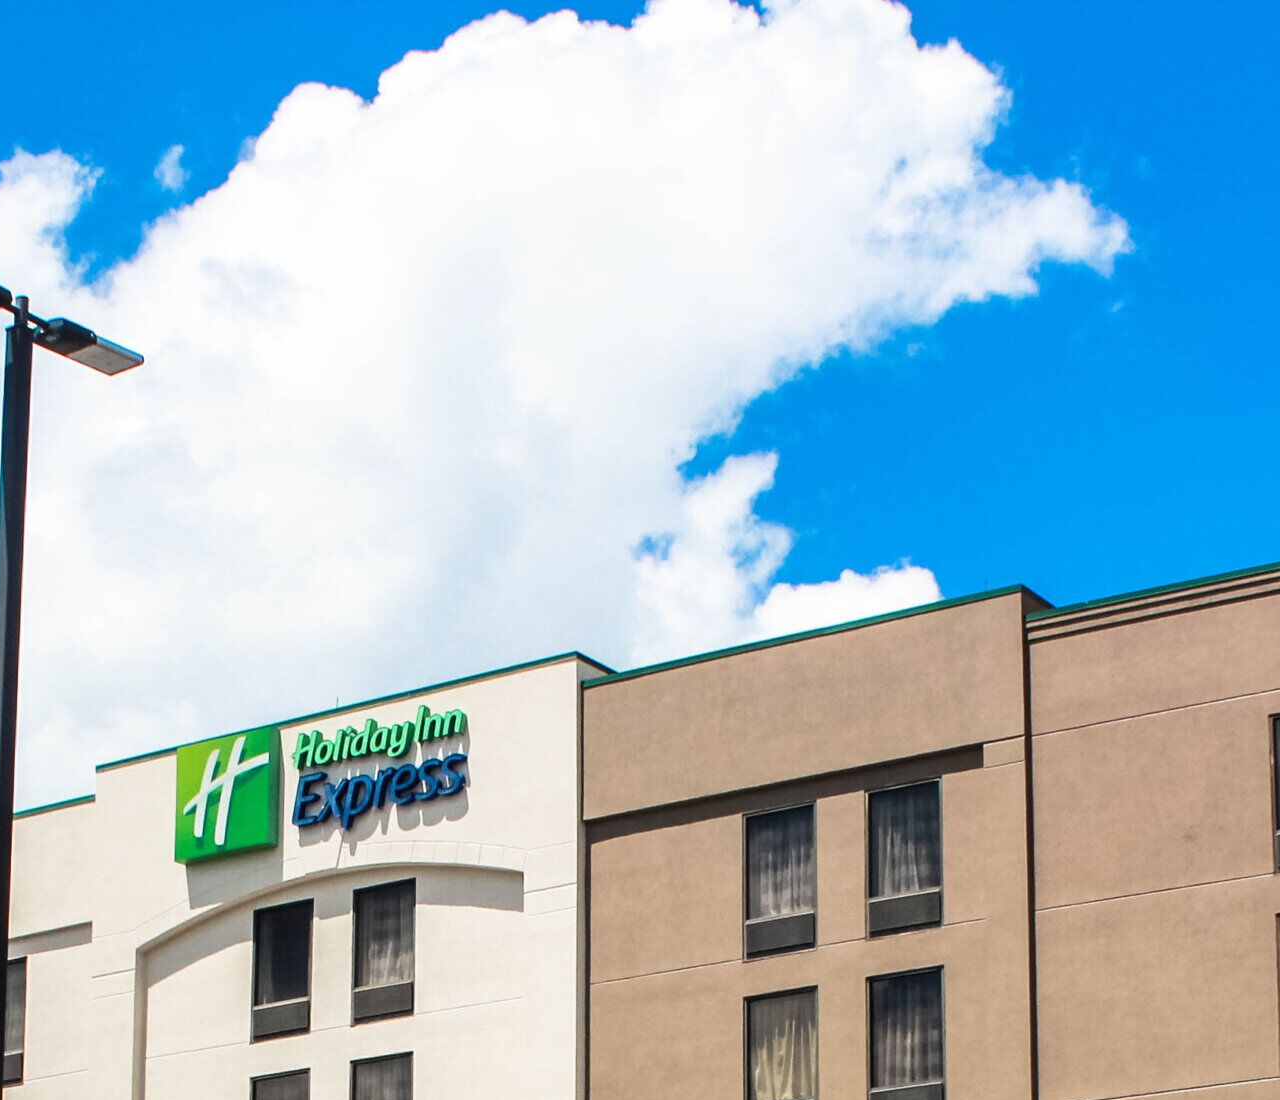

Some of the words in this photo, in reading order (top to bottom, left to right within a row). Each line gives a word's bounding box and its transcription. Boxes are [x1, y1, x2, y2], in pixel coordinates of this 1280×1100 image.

[293, 718, 414, 770] Holiday
[414, 704, 468, 743] Inn
[292, 753, 468, 830] Express
